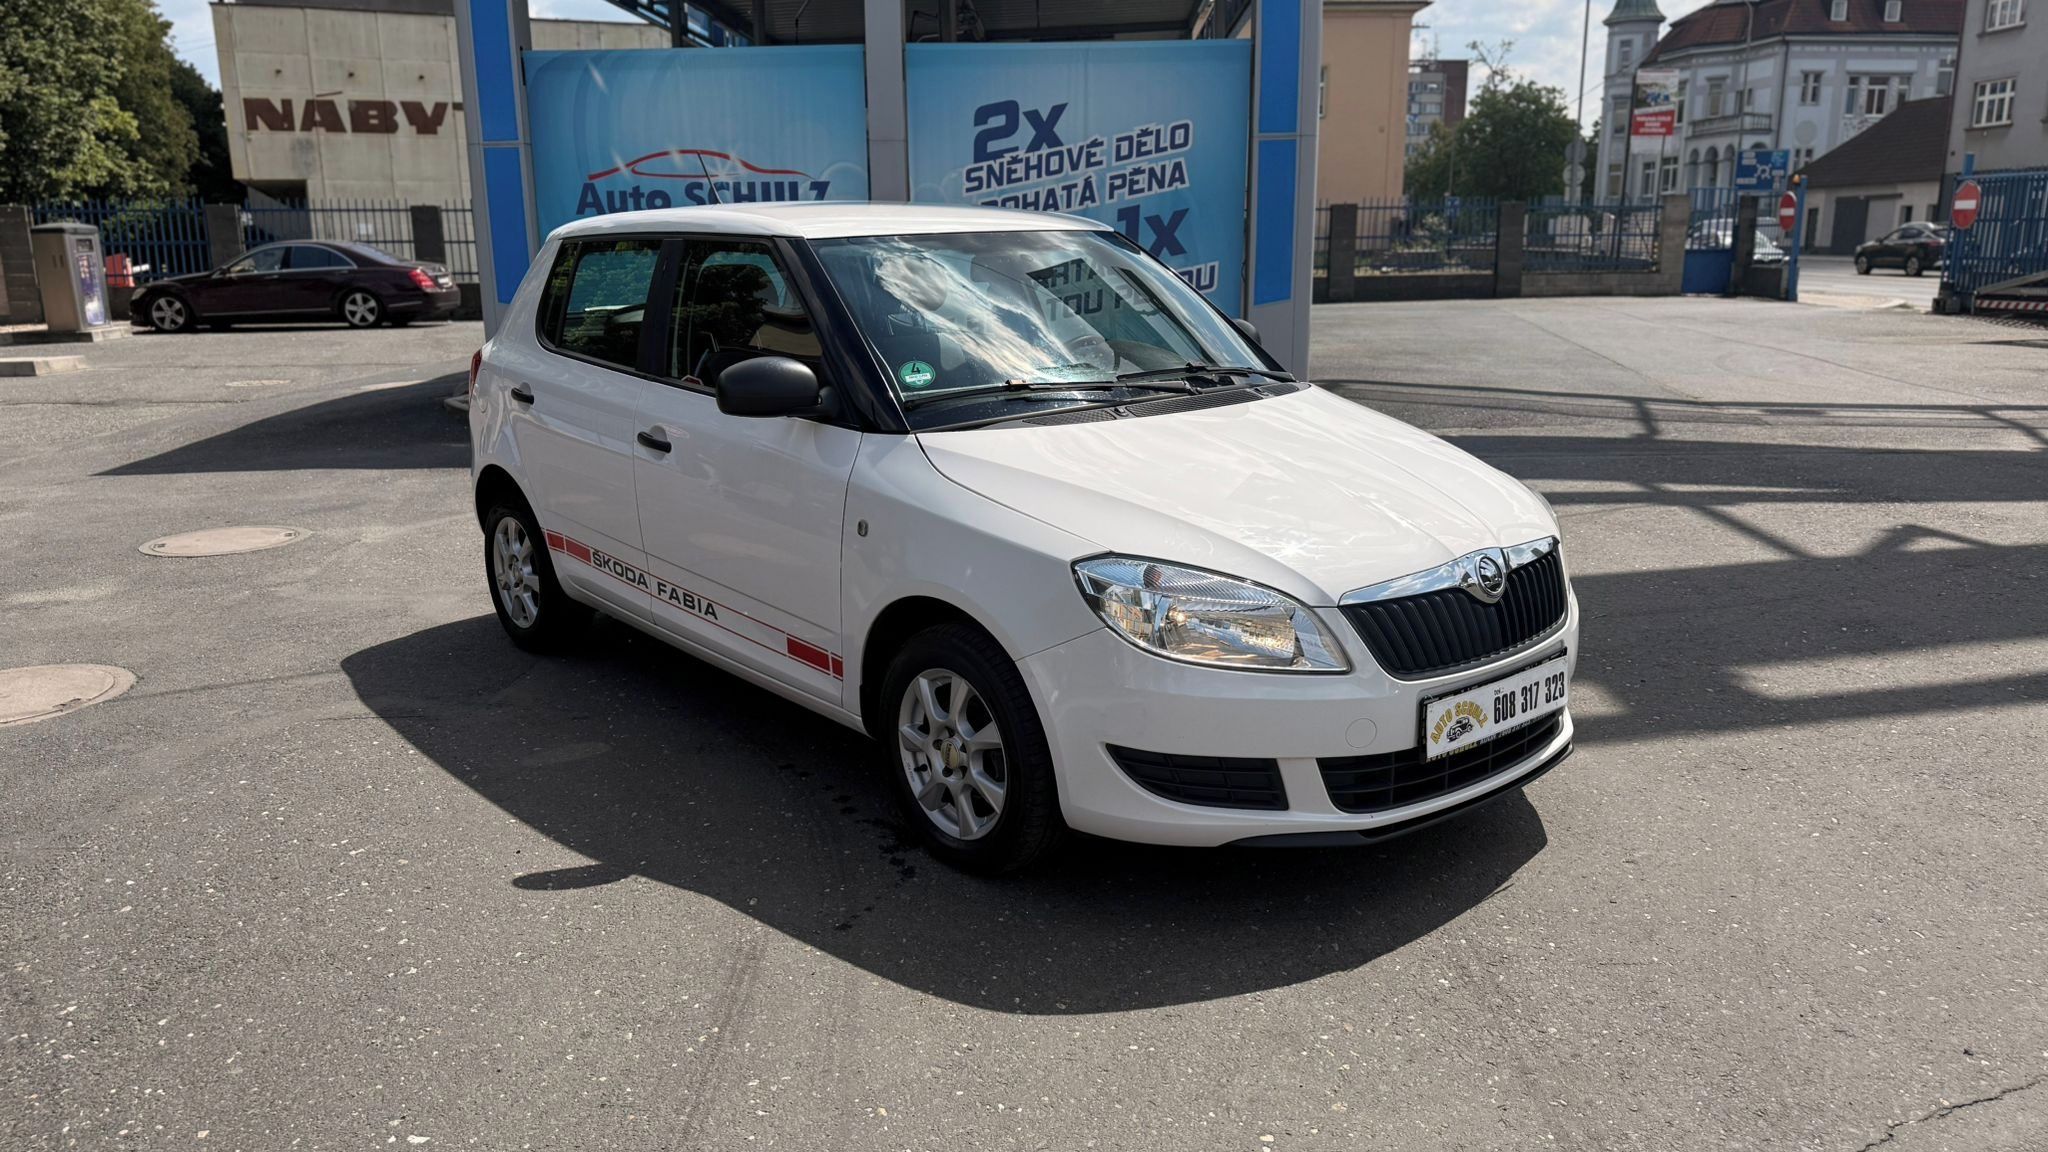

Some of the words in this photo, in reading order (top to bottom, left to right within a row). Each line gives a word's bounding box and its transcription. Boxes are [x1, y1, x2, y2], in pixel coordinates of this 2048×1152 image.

[243, 91, 464, 135] NÁBY
[973, 99, 1069, 164] 2x
[965, 138, 1104, 193] SNĚHOVÉ
[1115, 122, 1190, 163] DĚLO
[576, 182, 672, 215] Auto
[980, 175, 1098, 212] HATÁ
[1109, 160, 1187, 200] PĚNA
[1117, 204, 1190, 258] 1x
[911, 362, 921, 374] 4
[592, 549, 649, 590] ŠKODA
[657, 580, 719, 620] FABIA
[1430, 707, 1453, 744] AUTO
[1493, 690, 1516, 725] 608
[1521, 681, 1540, 714] 317
[1545, 671, 1565, 705] 323
